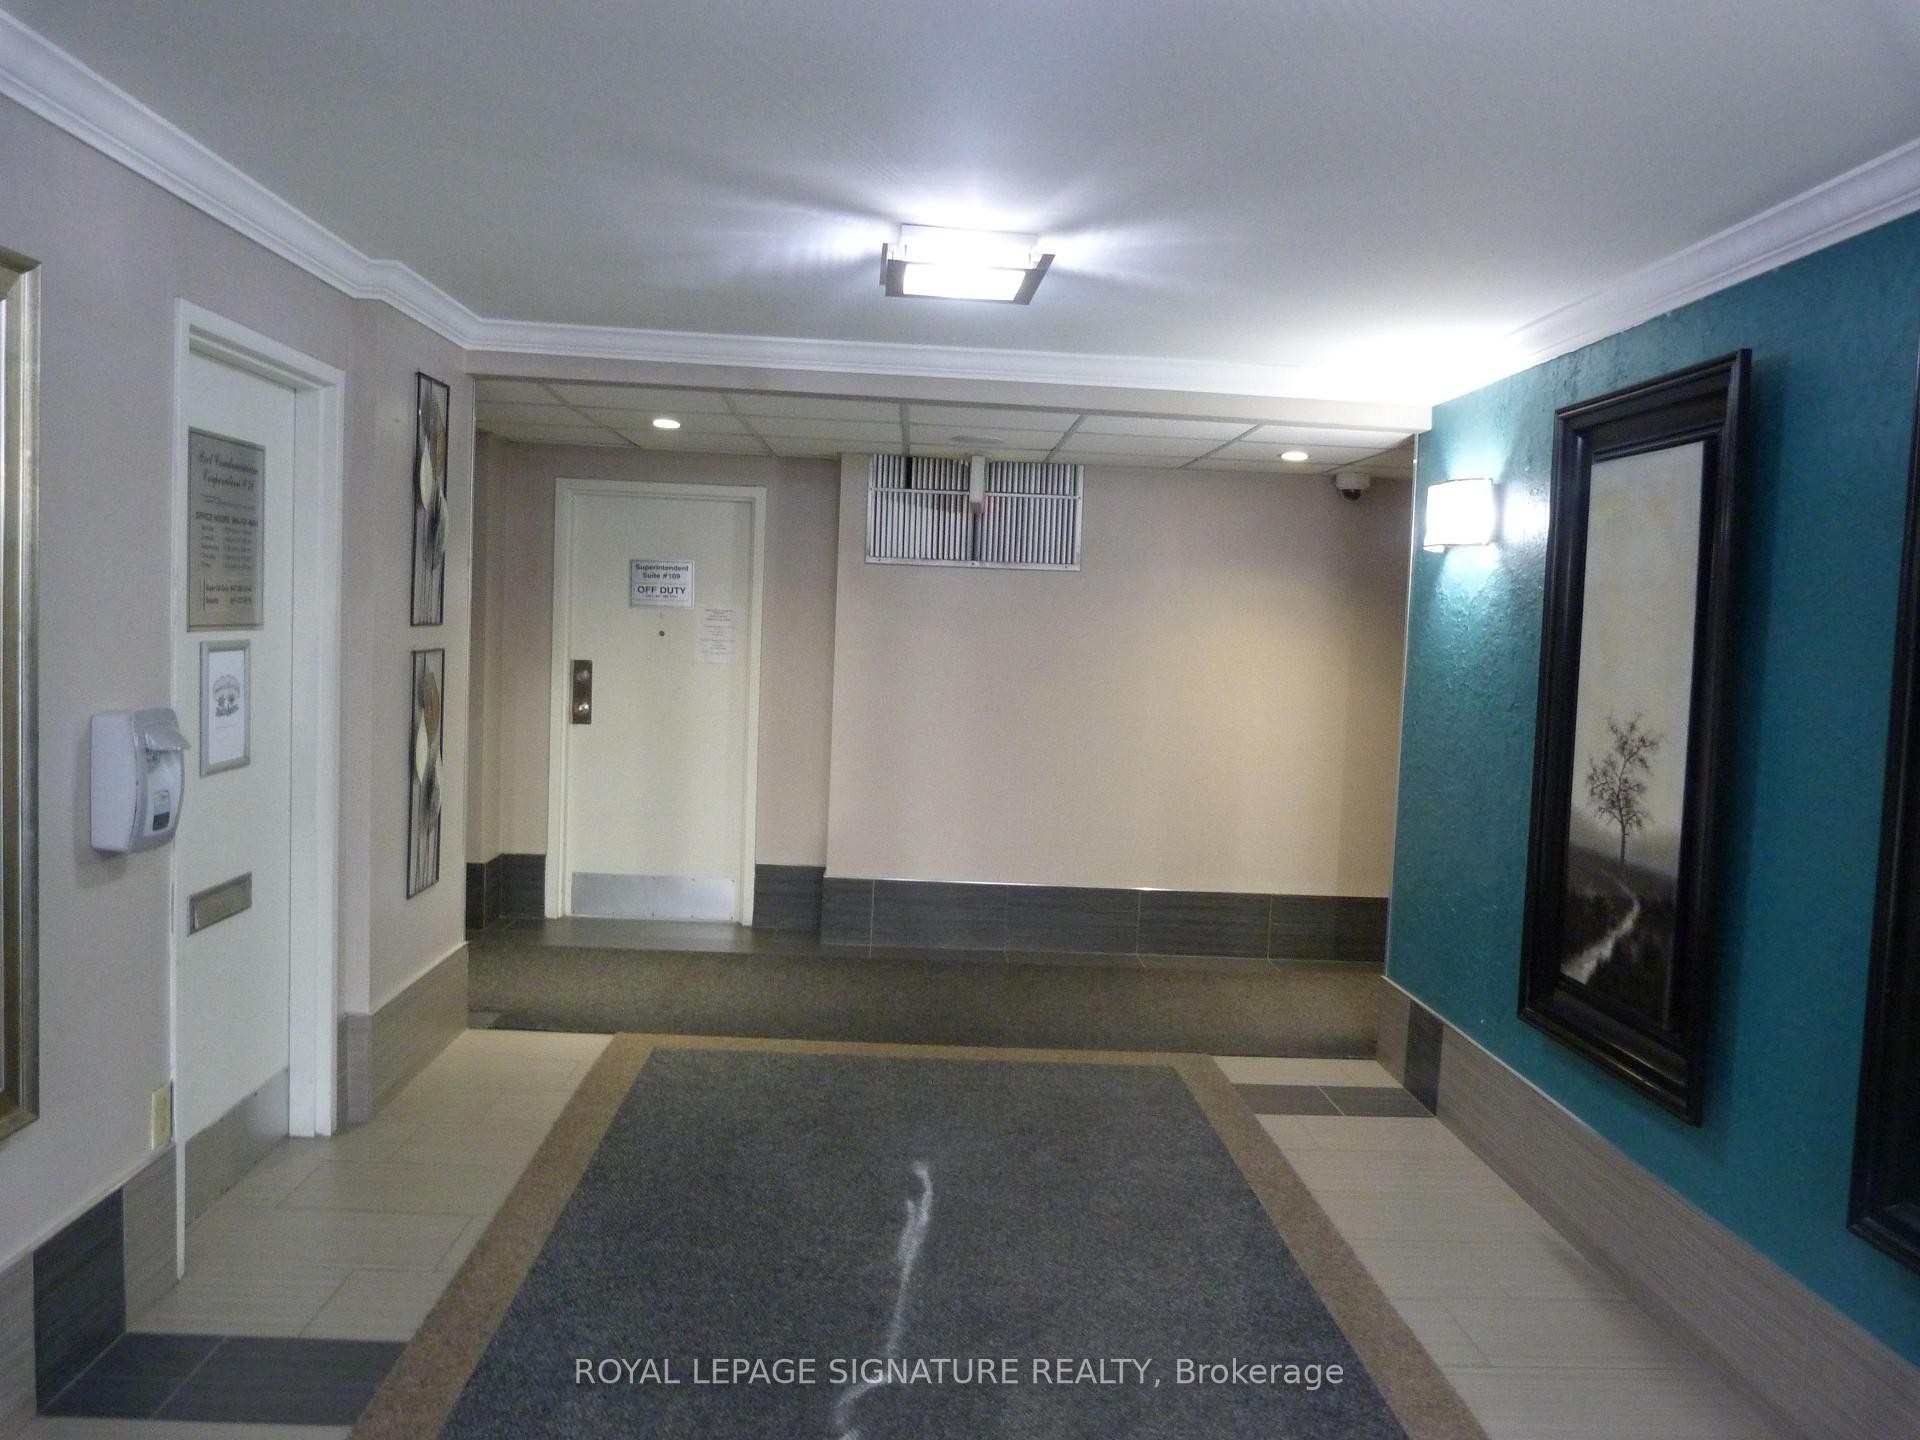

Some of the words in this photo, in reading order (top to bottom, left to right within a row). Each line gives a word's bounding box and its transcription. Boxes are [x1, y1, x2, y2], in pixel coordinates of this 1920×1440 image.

[635, 563, 689, 572] Superintendent
[637, 585, 657, 594] OFF
[660, 586, 686, 595] DUTY
